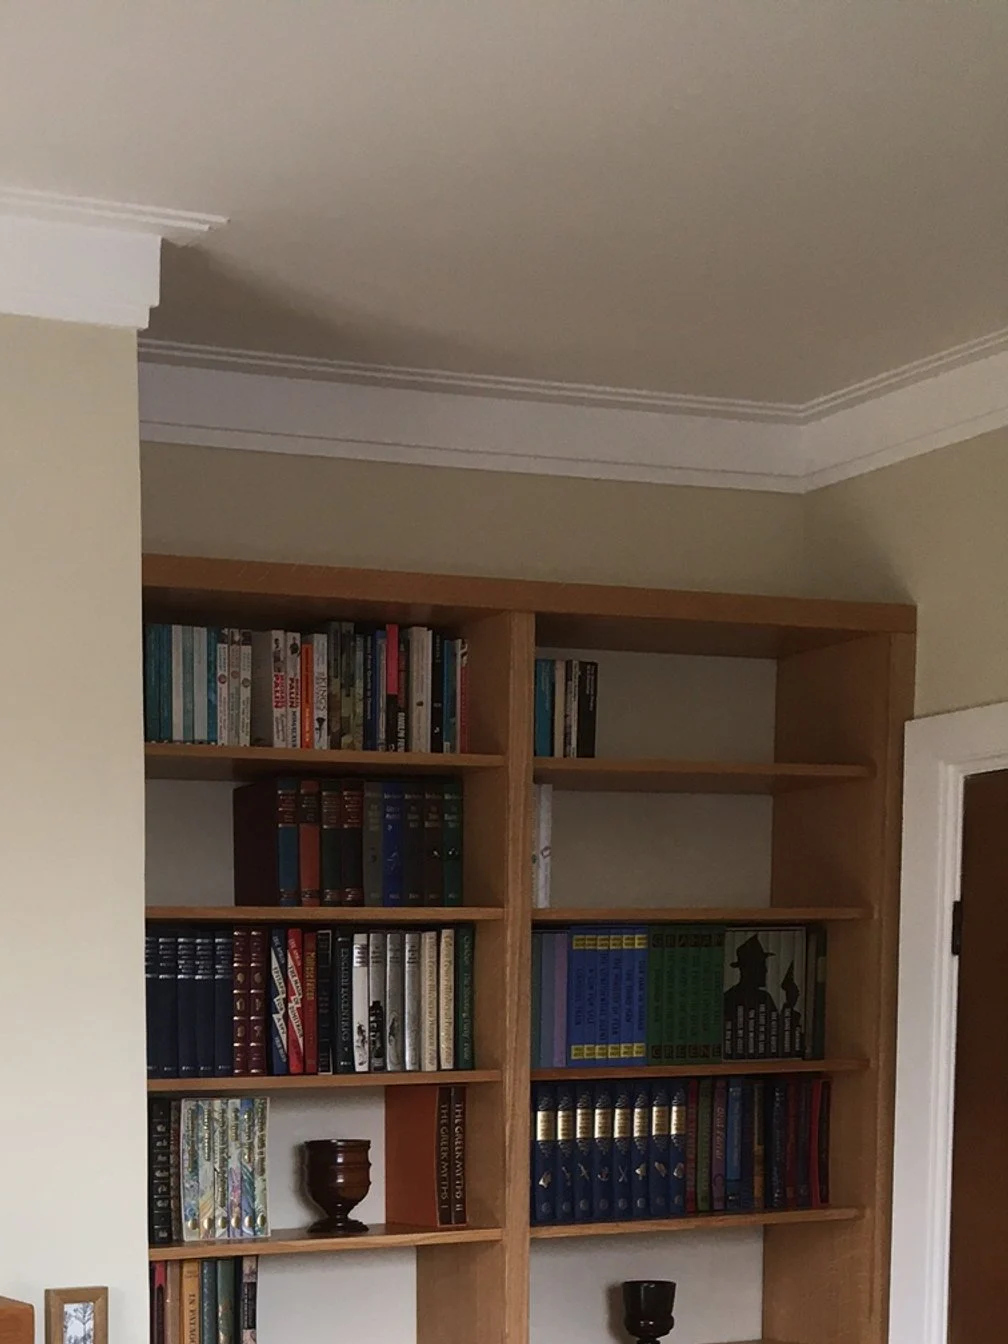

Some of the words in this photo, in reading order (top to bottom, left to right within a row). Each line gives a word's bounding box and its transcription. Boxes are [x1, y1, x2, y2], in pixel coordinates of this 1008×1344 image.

[652, 1044, 722, 1058] GREENE
[440, 1126, 449, 1159] GREEK
[455, 1127, 464, 1160] GREEK
[440, 1161, 449, 1200] MYTHS
[455, 1160, 464, 1199] MYTHS
[189, 1293, 196, 1304] IN
